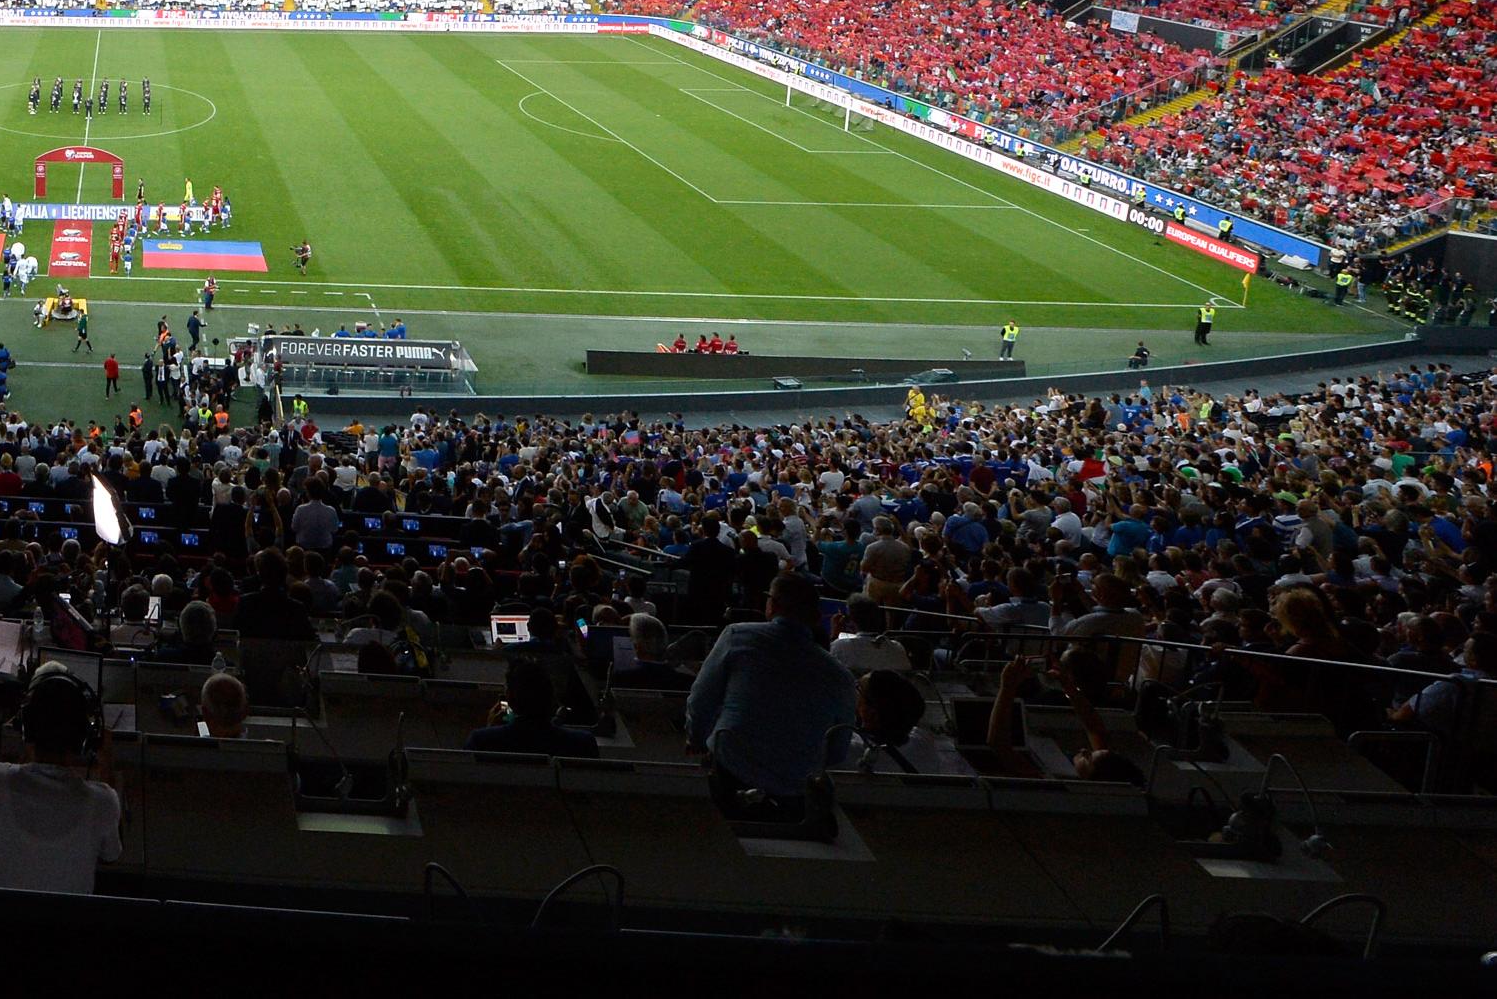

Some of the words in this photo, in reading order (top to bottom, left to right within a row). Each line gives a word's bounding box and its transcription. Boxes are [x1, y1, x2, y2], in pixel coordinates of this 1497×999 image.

[1001, 160, 1052, 187] www.figc.it
[1129, 208, 1164, 233] 00:00
[1166, 225, 1208, 249] EUROPEAN
[1208, 242, 1255, 269] QUALIFIERS
[395, 345, 434, 360] PUMA
